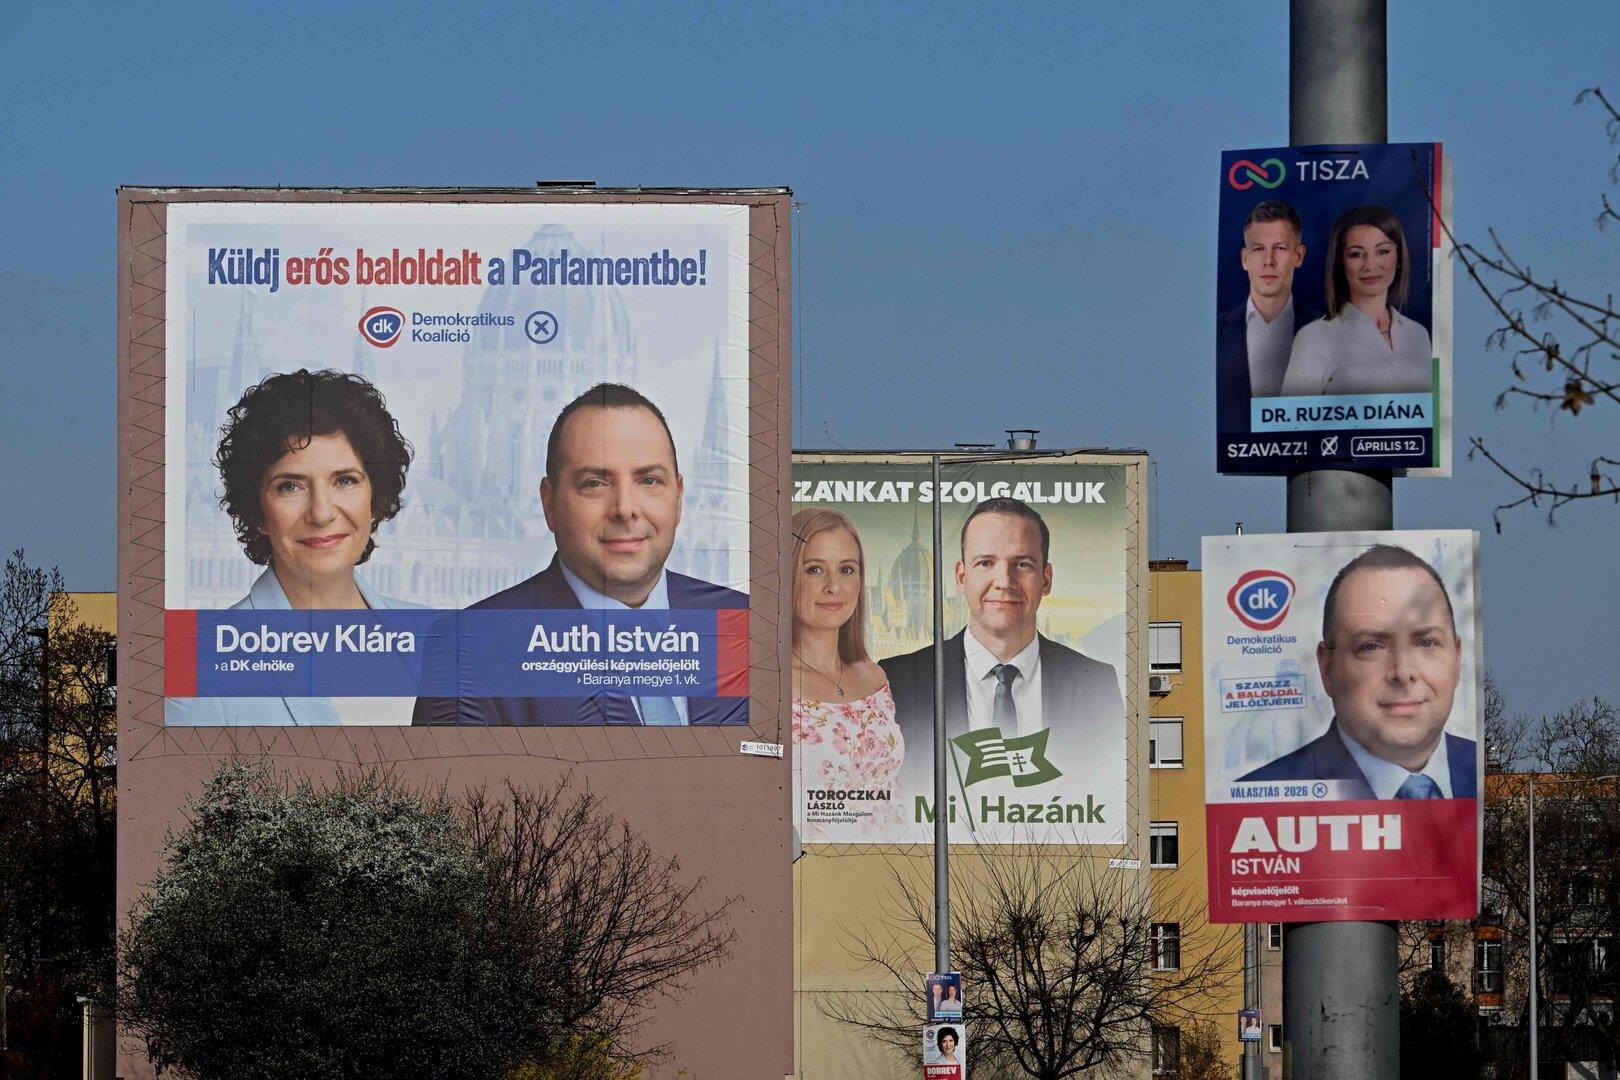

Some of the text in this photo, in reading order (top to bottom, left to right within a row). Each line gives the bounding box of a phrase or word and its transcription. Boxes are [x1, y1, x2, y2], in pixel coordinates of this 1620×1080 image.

[1296, 159, 1370, 182] TISZA
[208, 247, 707, 293] Küldj erős baloldalt a Parlamentbe!
[372, 318, 394, 334] dk
[412, 312, 515, 326] Demokratikus
[412, 328, 470, 343] Koalíció
[1261, 400, 1425, 423] DR. RUZSA DIÁNA
[1227, 441, 1308, 459] SZAVAZZ!
[1356, 440, 1419, 452] ÁPRILIS 12.
[791, 480, 1106, 504] ZÁNKAT SZOLGÁLJUK
[1248, 588, 1278, 610] dk
[216, 624, 416, 653] Dobrev Klára
[526, 624, 699, 653] Auth István
[1227, 634, 1297, 645] Demokratikus
[220, 660, 295, 672] a DK elnöke
[521, 659, 700, 673] országgyűlési képviselőjelölt
[583, 673, 700, 687] Baranya megye 1. vk.
[1235, 680, 1291, 690] SZAVAZZ
[1226, 688, 1303, 700] A BALOLDAL
[806, 789, 891, 801] TOROCZKAI
[1230, 785, 1308, 799] VÁLASZTÁS 2026
[807, 800, 845, 810] LÁSZLÓ
[915, 794, 1106, 824] Mi Hazánk
[1230, 814, 1402, 853] AUTH
[1231, 855, 1301, 875] ISTVÁN
[1231, 885, 1300, 896] képviselőjelölt
[1232, 899, 1261, 908] Baranya
[1262, 900, 1287, 908] megye
